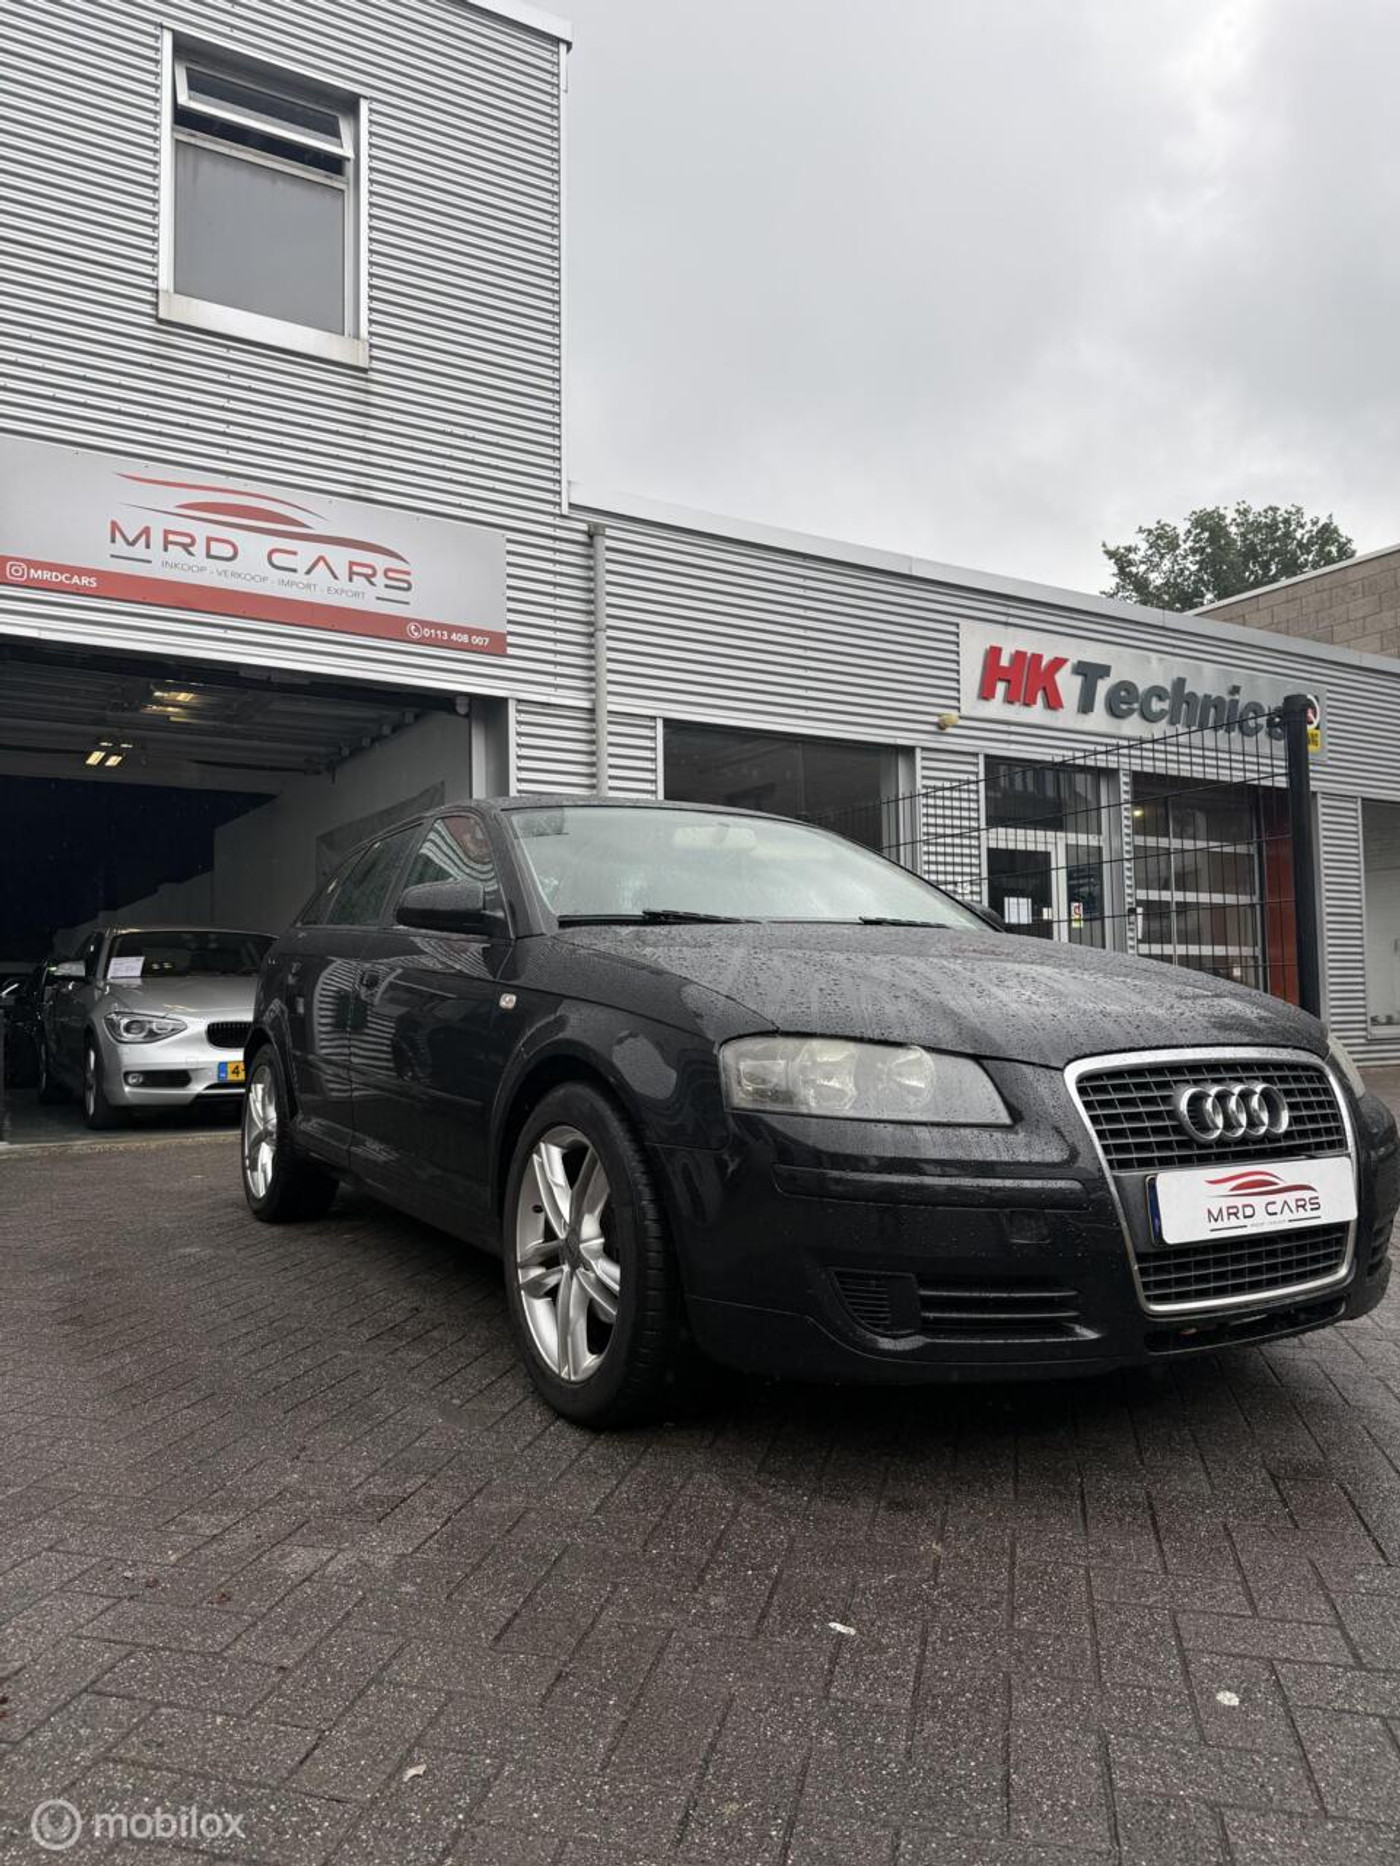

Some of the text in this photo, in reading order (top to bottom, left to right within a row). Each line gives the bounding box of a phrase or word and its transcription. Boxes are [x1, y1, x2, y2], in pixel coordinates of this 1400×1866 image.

[110, 520, 413, 592] MRD CARS
[29, 568, 98, 588] MRDCARS
[161, 560, 366, 600] INKOOP VERKOOP IMPORT EXPORT
[423, 628, 448, 640] 0113
[471, 635, 490, 646] 007
[1207, 1196, 1321, 1223] MRD CARS
